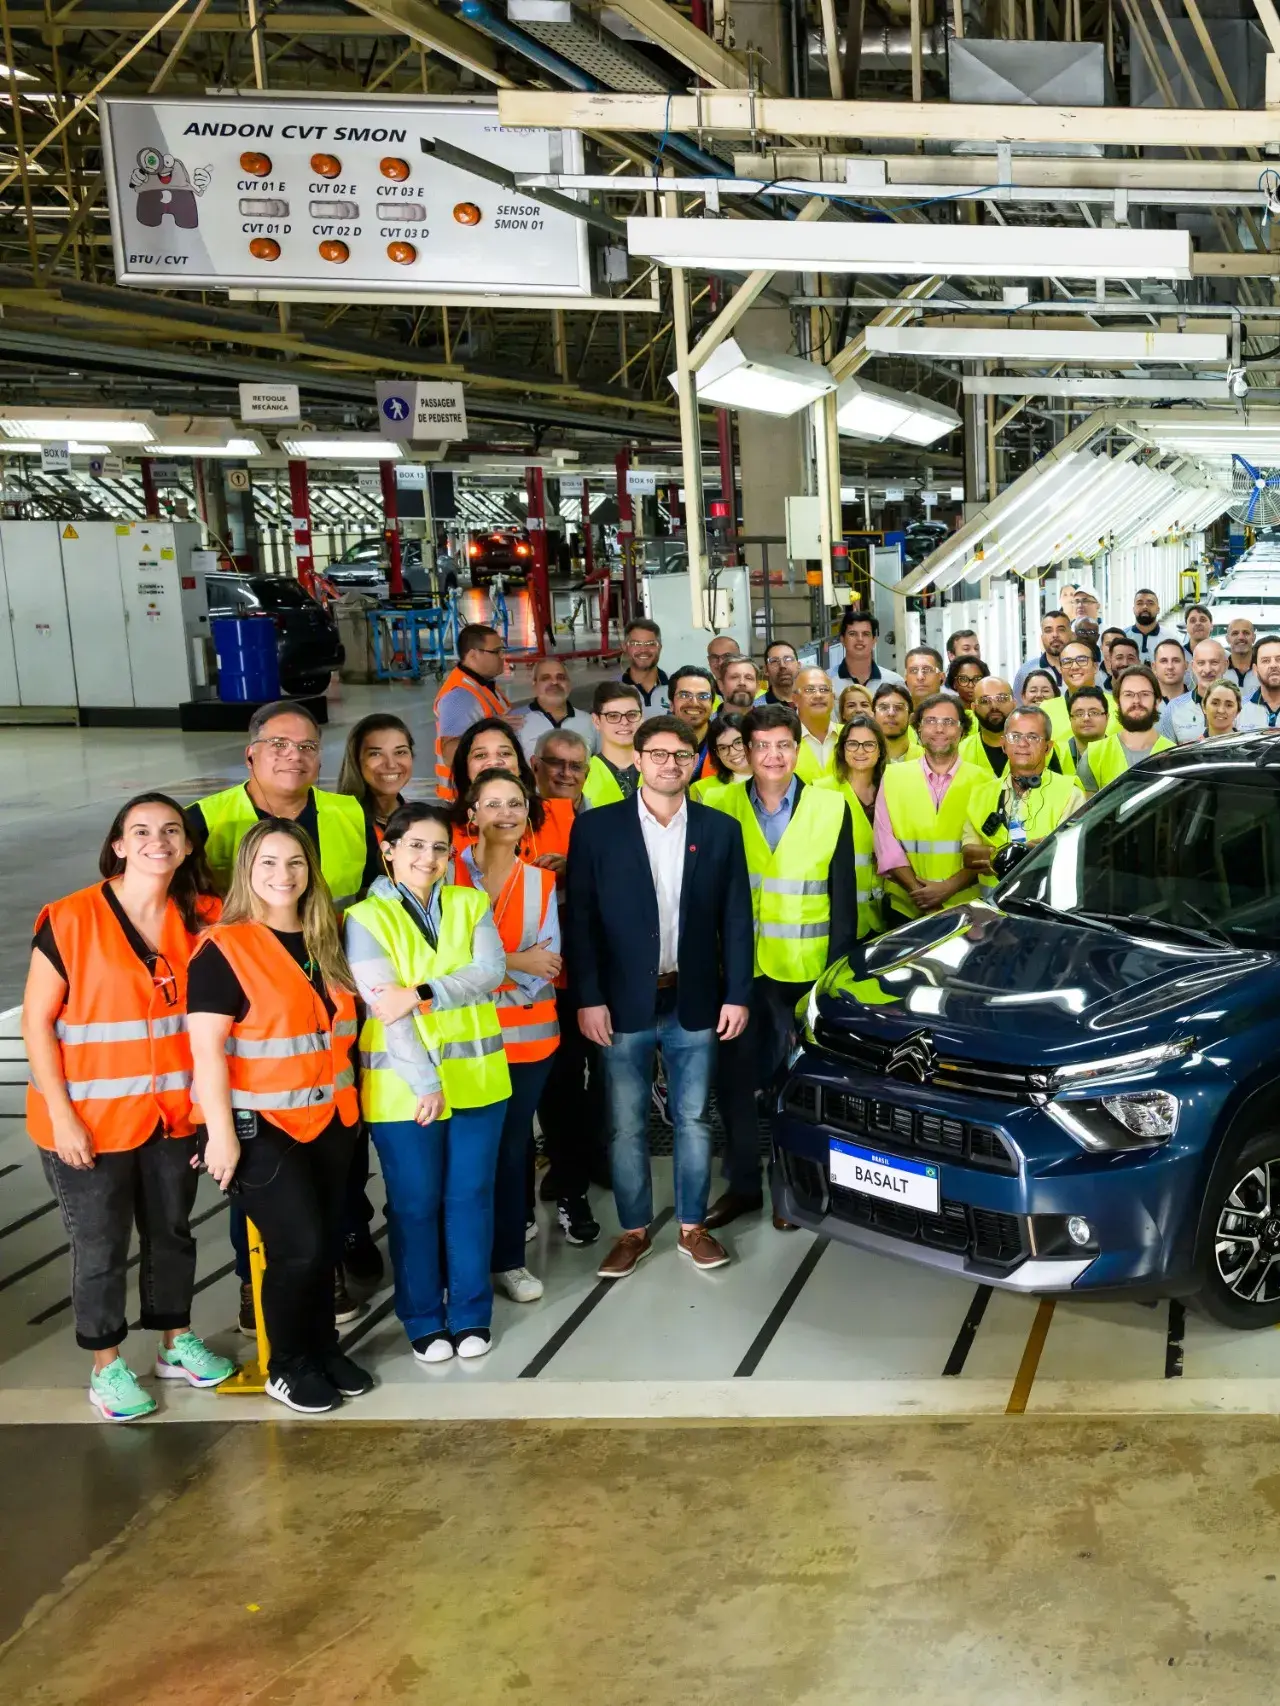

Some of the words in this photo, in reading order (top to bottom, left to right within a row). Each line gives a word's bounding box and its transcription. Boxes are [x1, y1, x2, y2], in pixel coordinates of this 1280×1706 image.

[183, 122, 274, 138] ANDON
[281, 125, 328, 140] CVT
[333, 127, 407, 143] SMON
[237, 180, 258, 191] CVT
[261, 181, 274, 192] 01
[278, 181, 286, 192] E
[308, 183, 331, 194] CVT
[333, 184, 347, 194] 02
[349, 184, 357, 195] E
[376, 186, 399, 196] CVT
[400, 187, 414, 197] 03
[417, 187, 425, 197] E
[497, 205, 540, 216] SENSOR
[242, 223, 264, 234] CVT
[266, 223, 279, 234] 01
[283, 224, 292, 234] D
[494, 219, 528, 230] SMON
[531, 220, 544, 230] 01
[312, 225, 334, 236] CVT
[336, 225, 351, 236] 02
[353, 226, 362, 236] D
[380, 227, 402, 237] CVT
[404, 228, 417, 238] 03
[421, 228, 429, 238] D
[129, 254, 154, 264] BTU
[155, 255, 161, 265] /
[164, 255, 189, 265] CVT
[420, 398, 456, 408] PASSAGEM
[417, 413, 428, 423] DE
[428, 413, 462, 423] PEDESTRE
[44, 448, 60, 457] BOX
[871, 1155, 890, 1165] BRASIL
[855, 1165, 909, 1194] BASALT
